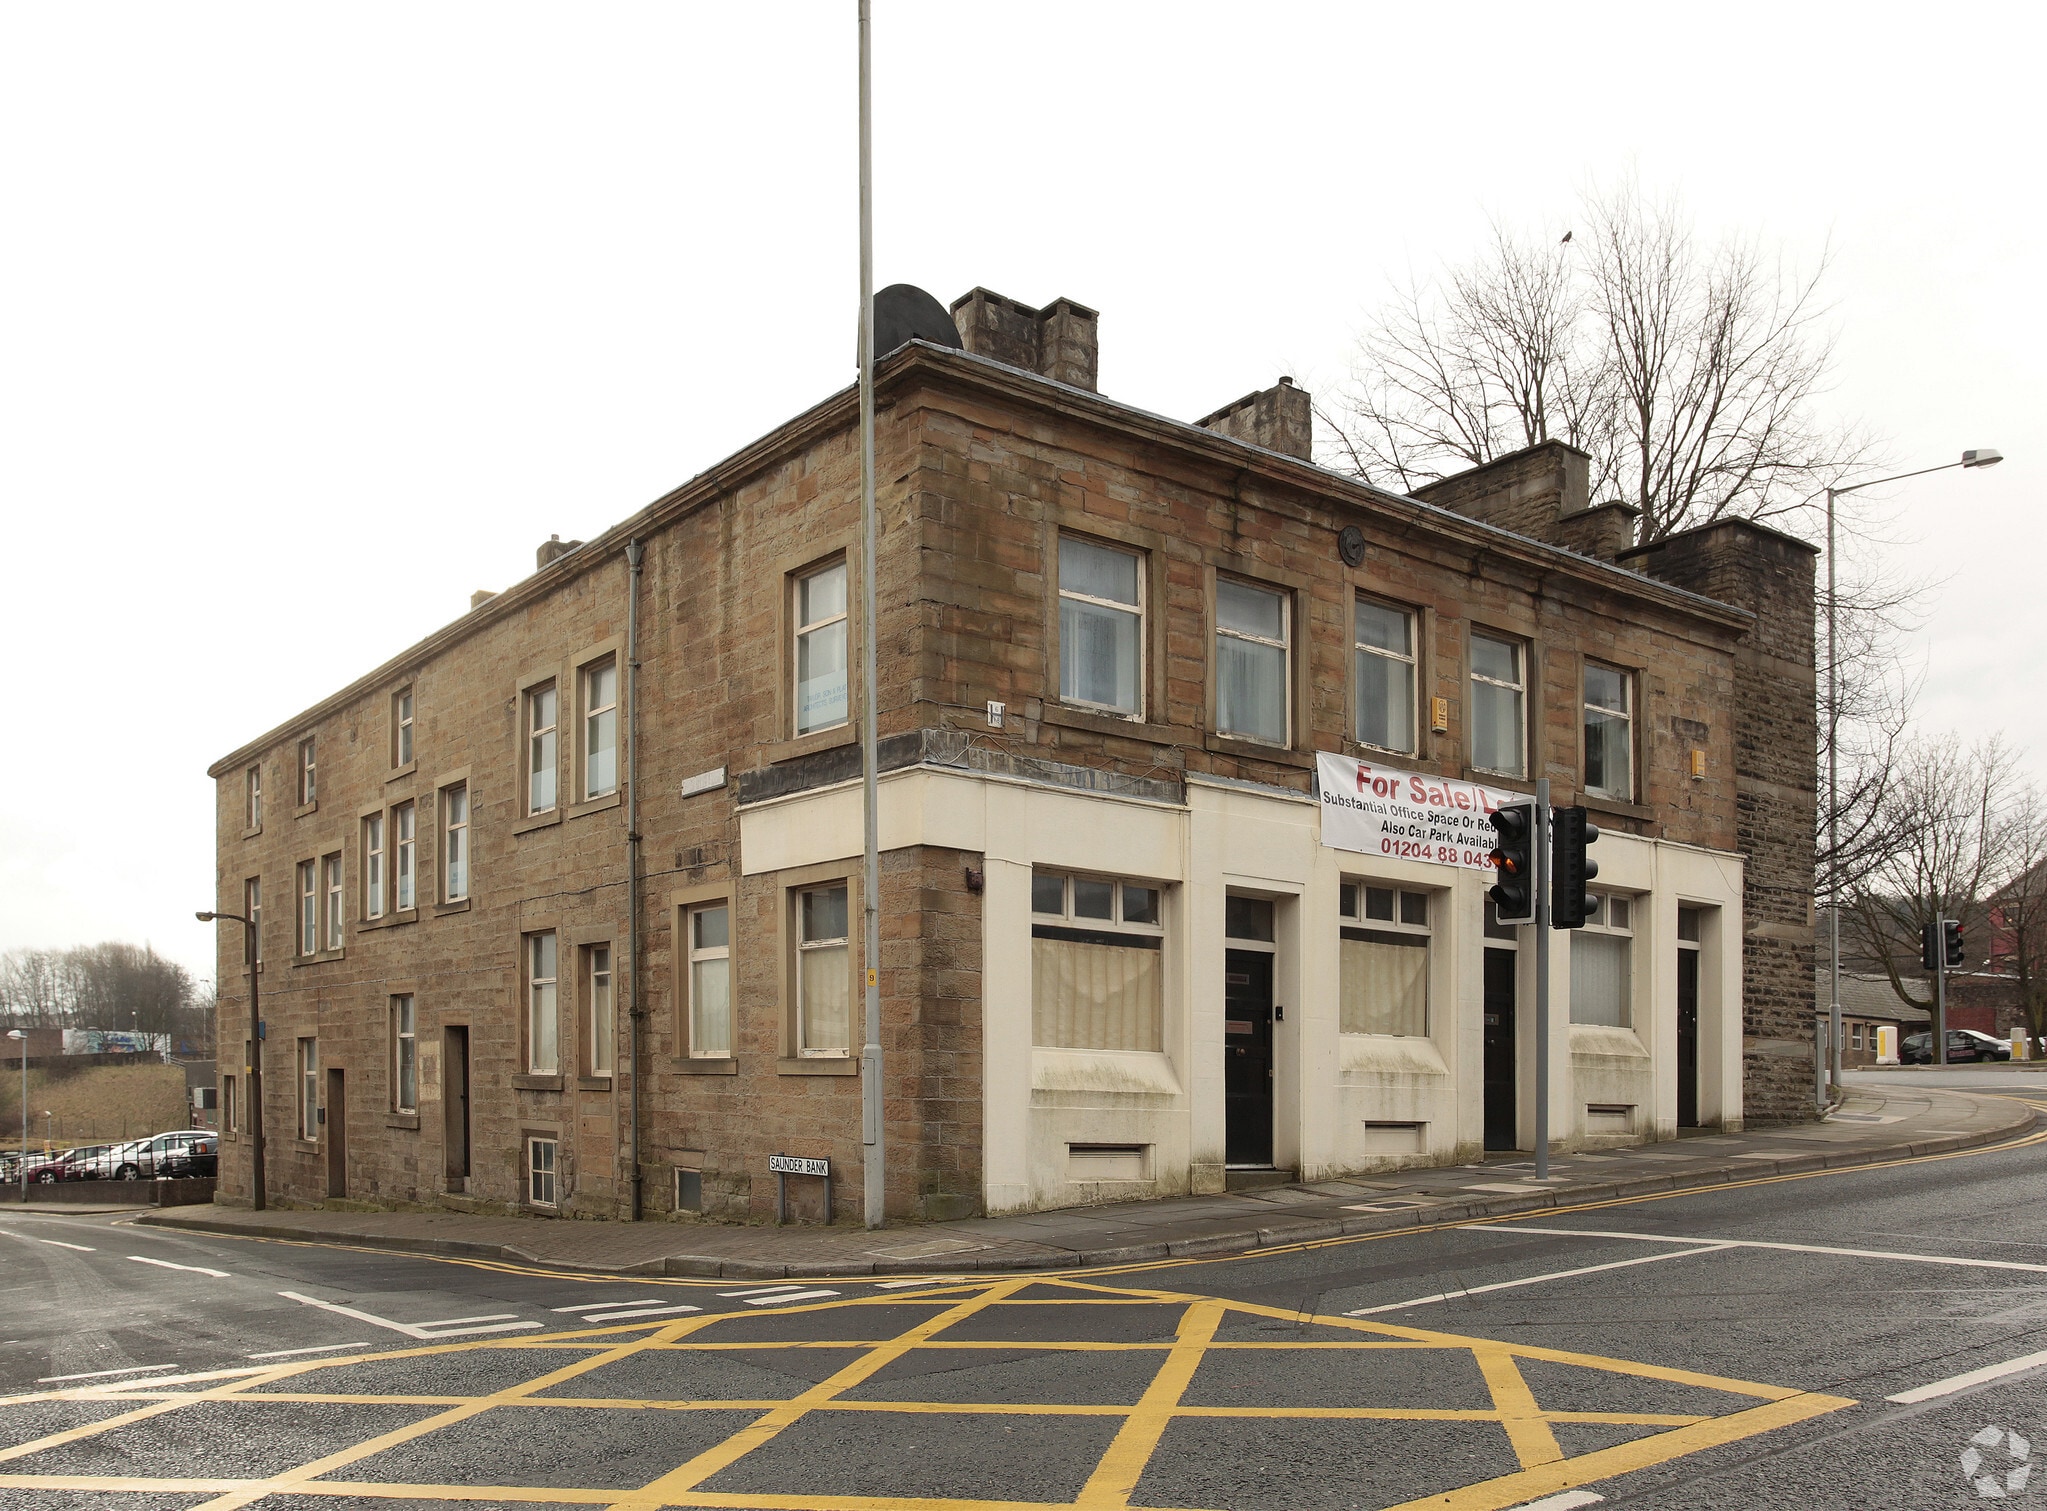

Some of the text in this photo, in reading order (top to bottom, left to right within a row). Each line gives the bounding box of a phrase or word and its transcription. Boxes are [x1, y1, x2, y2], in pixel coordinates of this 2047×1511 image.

[1356, 764, 1514, 814] For Sale/L
[1323, 790, 1387, 815] Substantial
[1390, 804, 1424, 821] Office
[1427, 810, 1459, 827] Space
[1462, 815, 1475, 829] Or
[1381, 820, 1497, 850] Also Car Park Availabl
[1381, 837, 1498, 869] 01204 88 043
[869, 974, 875, 982] 9
[770, 1157, 827, 1175] SAUNDER BANK
